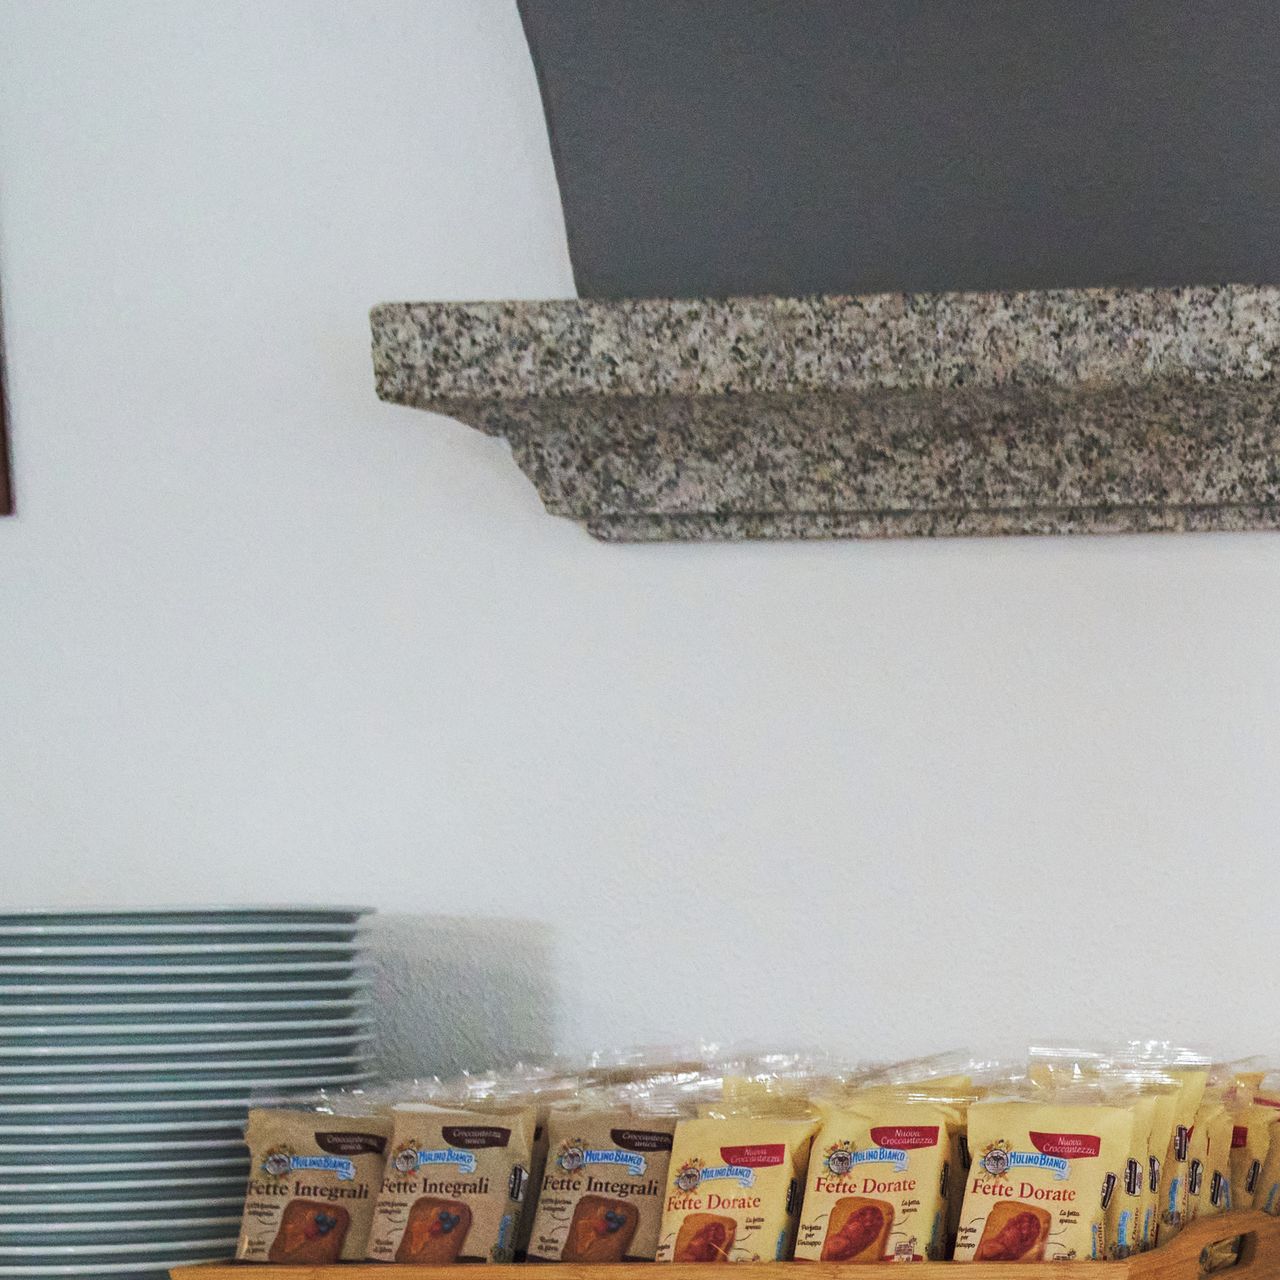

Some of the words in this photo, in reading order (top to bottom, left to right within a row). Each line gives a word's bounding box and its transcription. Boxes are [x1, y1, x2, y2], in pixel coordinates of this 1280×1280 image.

[881, 1136, 934, 1145] Croccantezza
[894, 1128, 921, 1137] Nuova
[1058, 1137, 1082, 1146] Nuova
[1043, 1143, 1097, 1155] Croccantezza
[249, 1180, 288, 1196] Fette
[295, 1182, 369, 1200] Integrali
[380, 1178, 416, 1194] Fette
[422, 1177, 490, 1197] Integrali
[543, 1175, 581, 1192] Fette
[586, 1175, 659, 1198] Integrali
[815, 1176, 857, 1194] Fette
[862, 1178, 916, 1195] Dorate
[971, 1179, 1014, 1198] Fette
[1020, 1182, 1076, 1202] Dorate
[667, 1195, 702, 1212] Fette
[706, 1193, 761, 1210] Dorate
